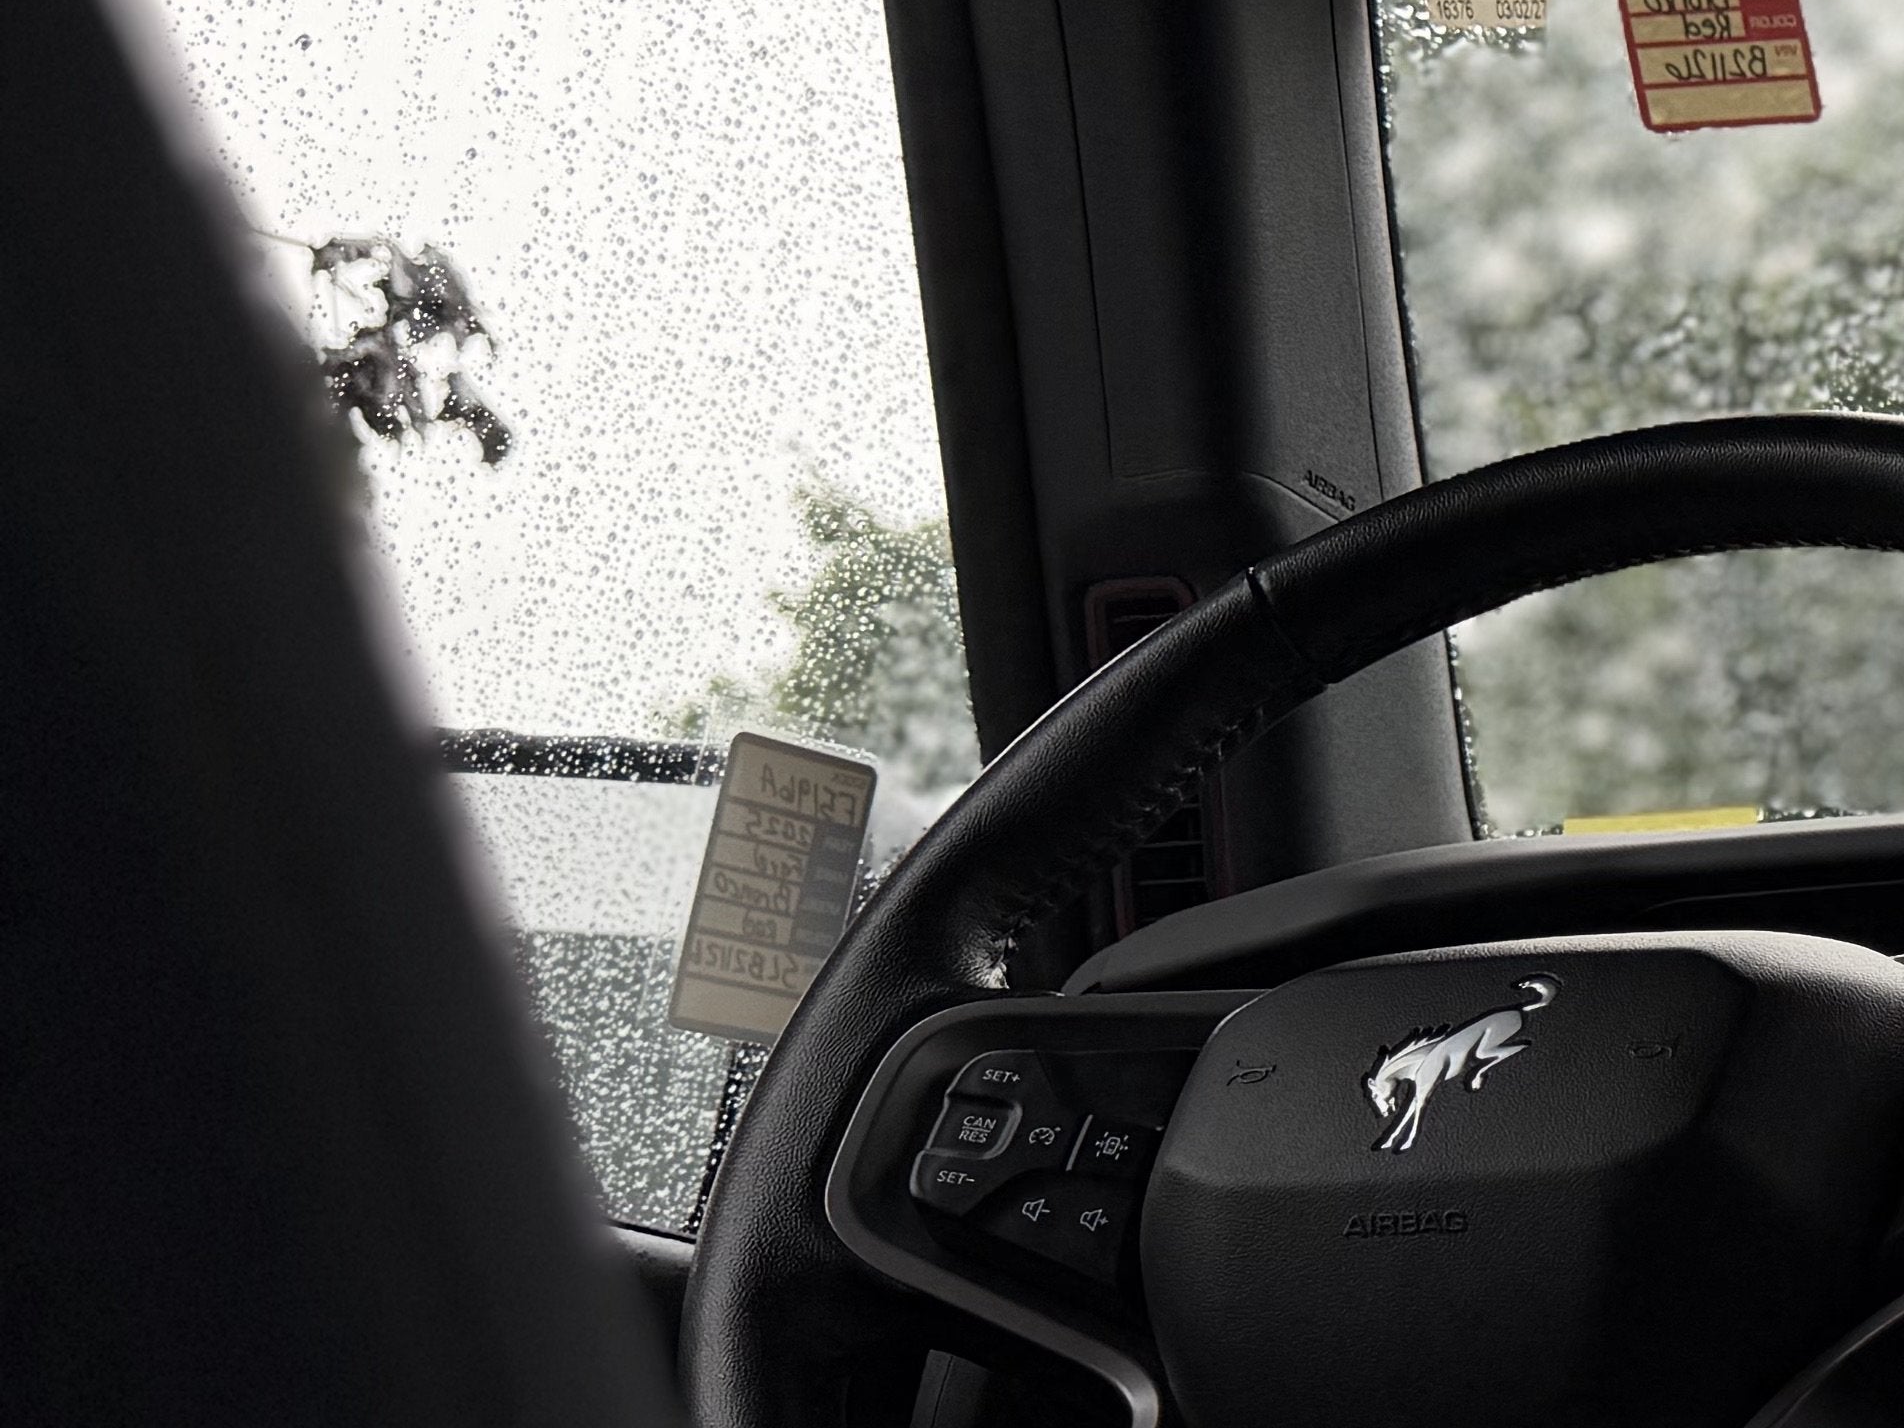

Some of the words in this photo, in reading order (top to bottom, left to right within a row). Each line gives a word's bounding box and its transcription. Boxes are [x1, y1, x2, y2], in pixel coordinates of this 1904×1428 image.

[1437, 0, 1474, 20] 16376
[1304, 470, 1356, 511] AIRBAG
[962, 1115, 997, 1131] CAN
[958, 1128, 989, 1144] RES
[1342, 1208, 1470, 1240] AIRBAG
